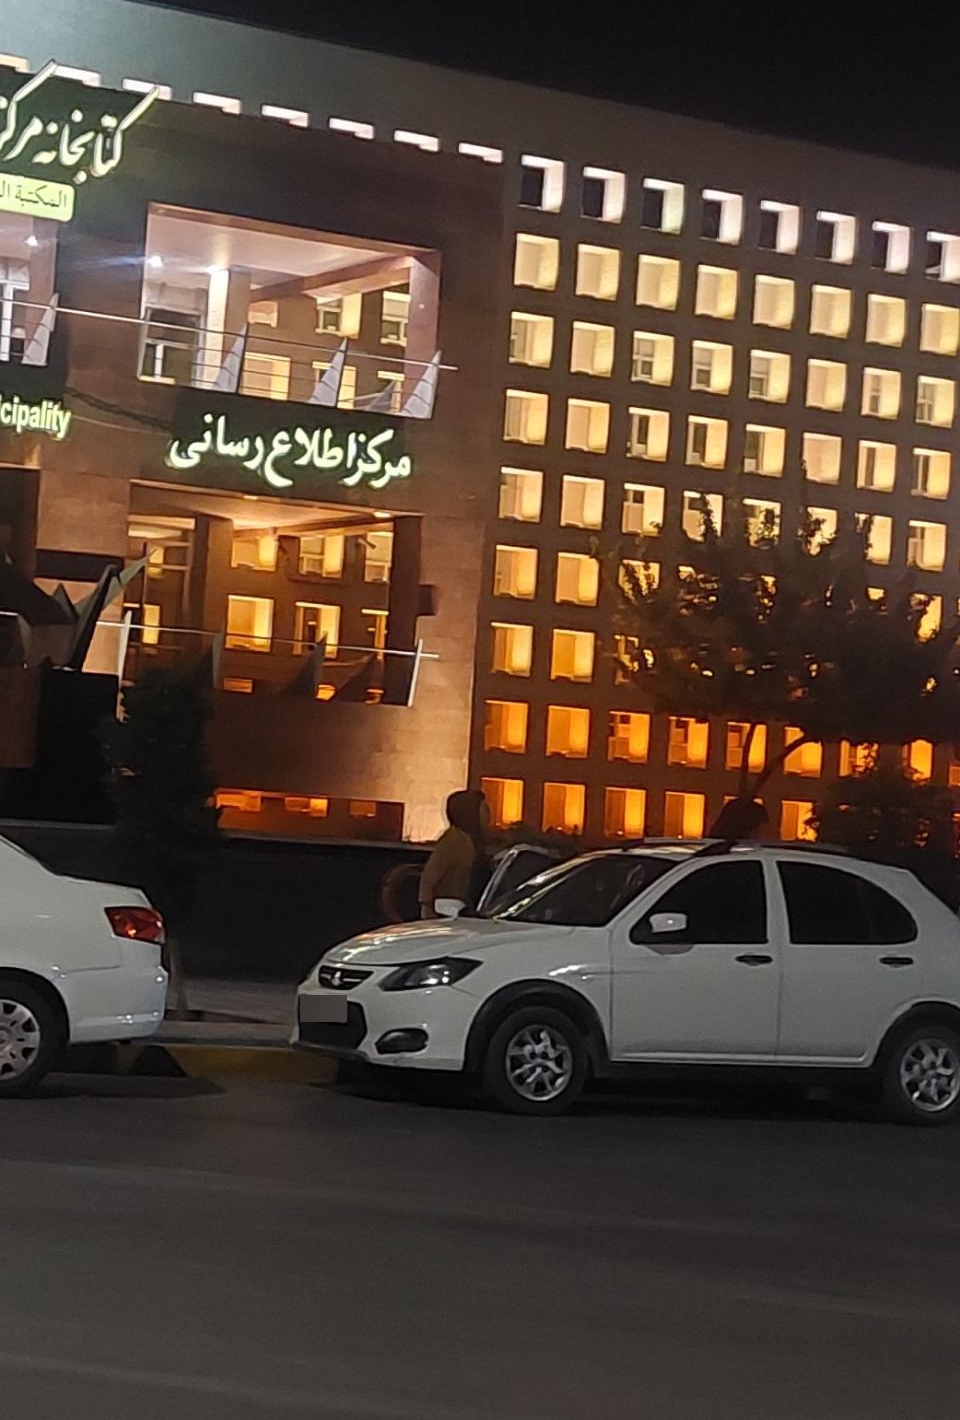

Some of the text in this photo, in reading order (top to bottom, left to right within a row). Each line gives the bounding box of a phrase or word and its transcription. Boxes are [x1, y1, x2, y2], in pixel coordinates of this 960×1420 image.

[32, 86, 160, 184] کتابخانه
[165, 412, 412, 489] مرکز اطلاع رسانی
